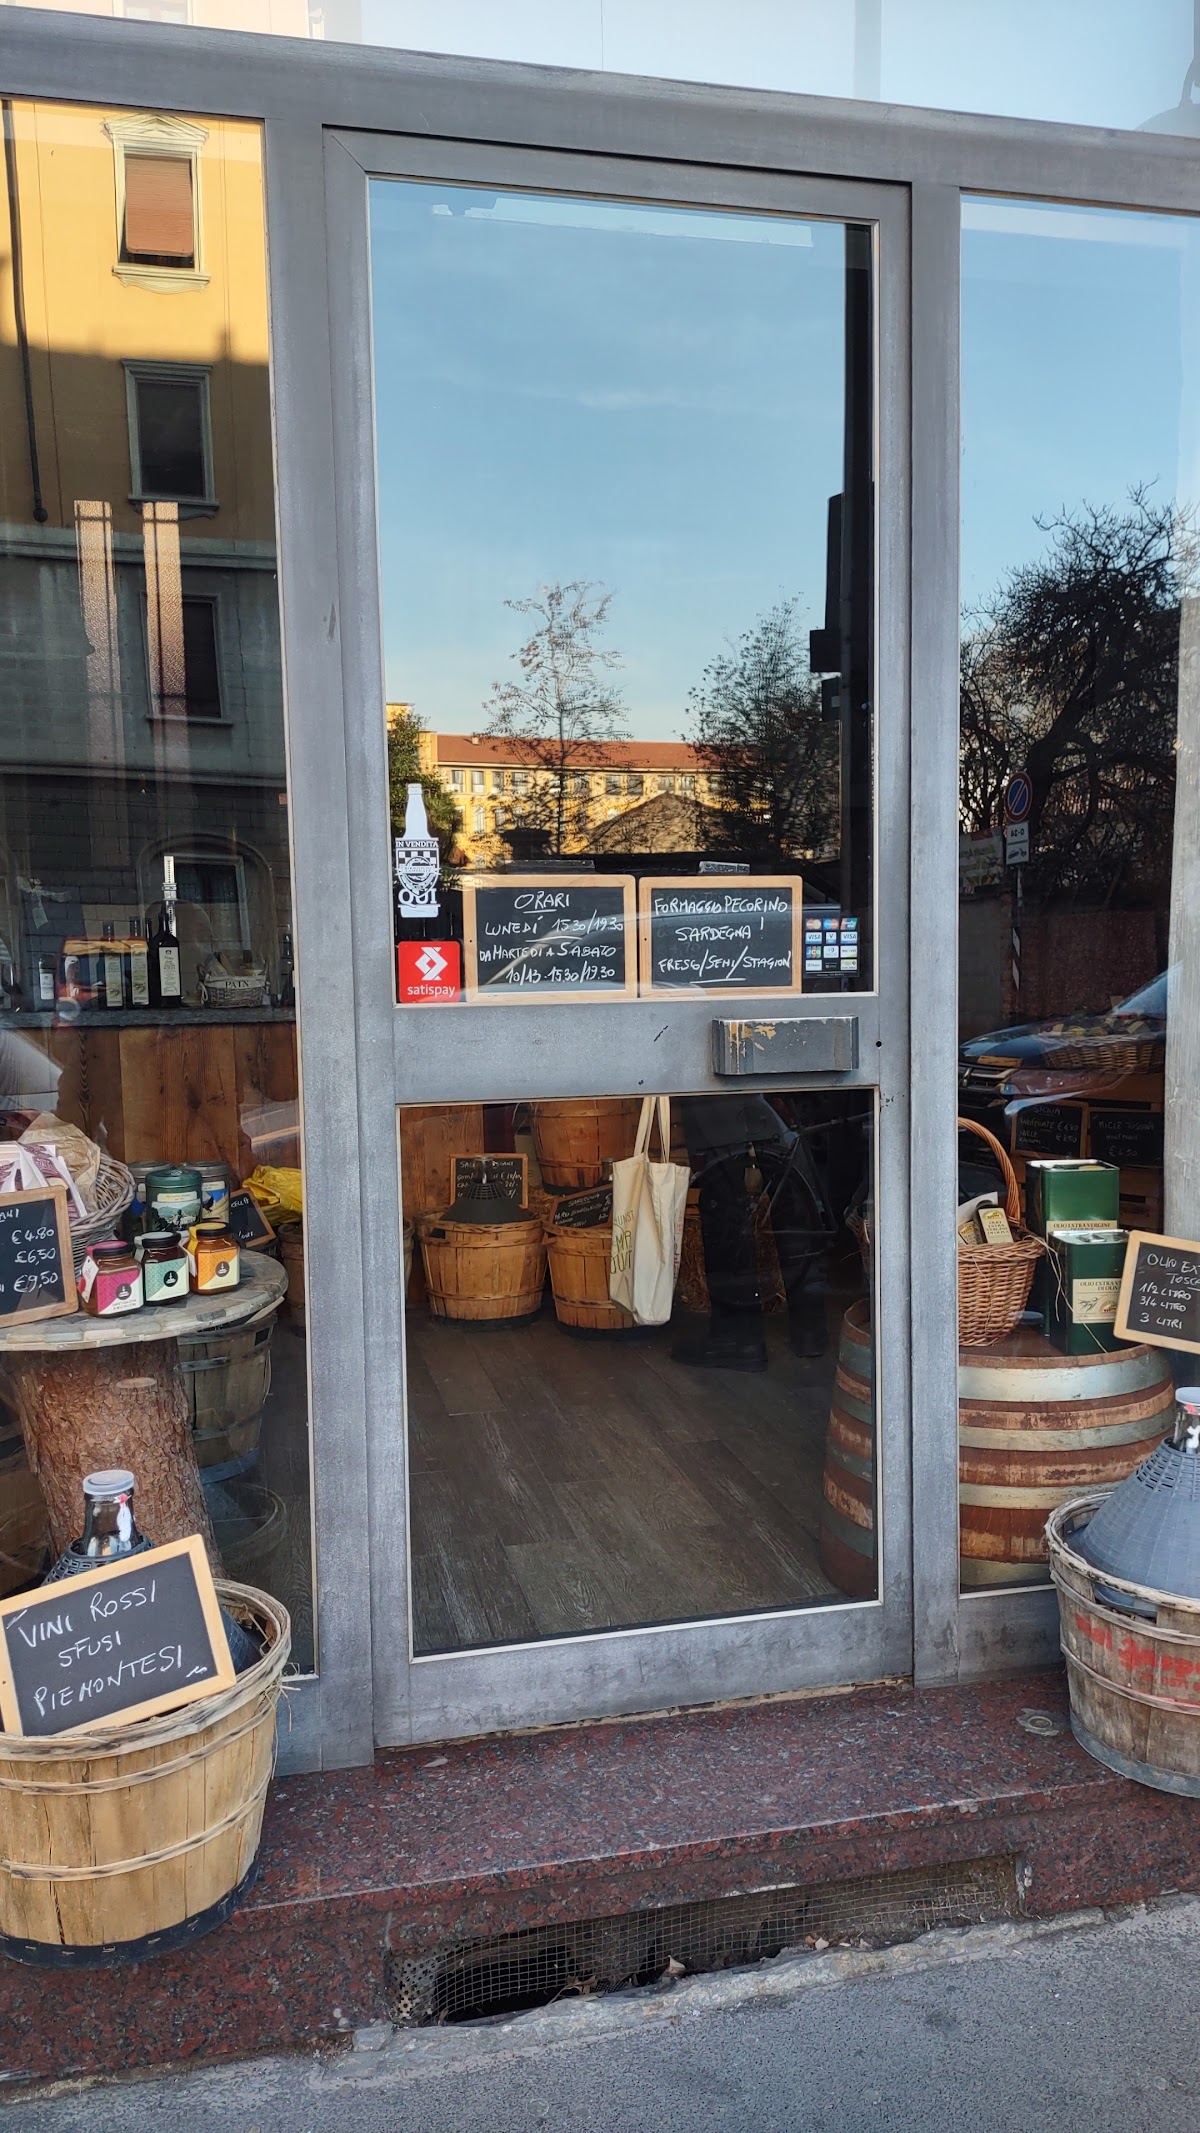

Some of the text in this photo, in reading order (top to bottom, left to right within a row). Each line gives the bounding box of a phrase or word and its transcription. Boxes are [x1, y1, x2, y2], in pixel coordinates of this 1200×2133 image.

[398, 888, 438, 904] QUI
[514, 890, 570, 909] ORARI
[655, 895, 788, 916] FORMAGGIO PECORINO
[675, 925, 751, 942] SARDEGNA
[557, 942, 616, 957] SABATO
[407, 984, 456, 998] satispay
[1147, 1253, 1177, 1269] OLIO
[1139, 1282, 1192, 1300] 1/2 LITRO
[1139, 1295, 1157, 1307] 3/4
[1140, 1312, 1182, 1329] 3 LITRI
[18, 1579, 156, 1648] VINI ROSSI
[58, 1630, 122, 1668] SFUSI
[33, 1644, 182, 1717] PIEMONTESI
